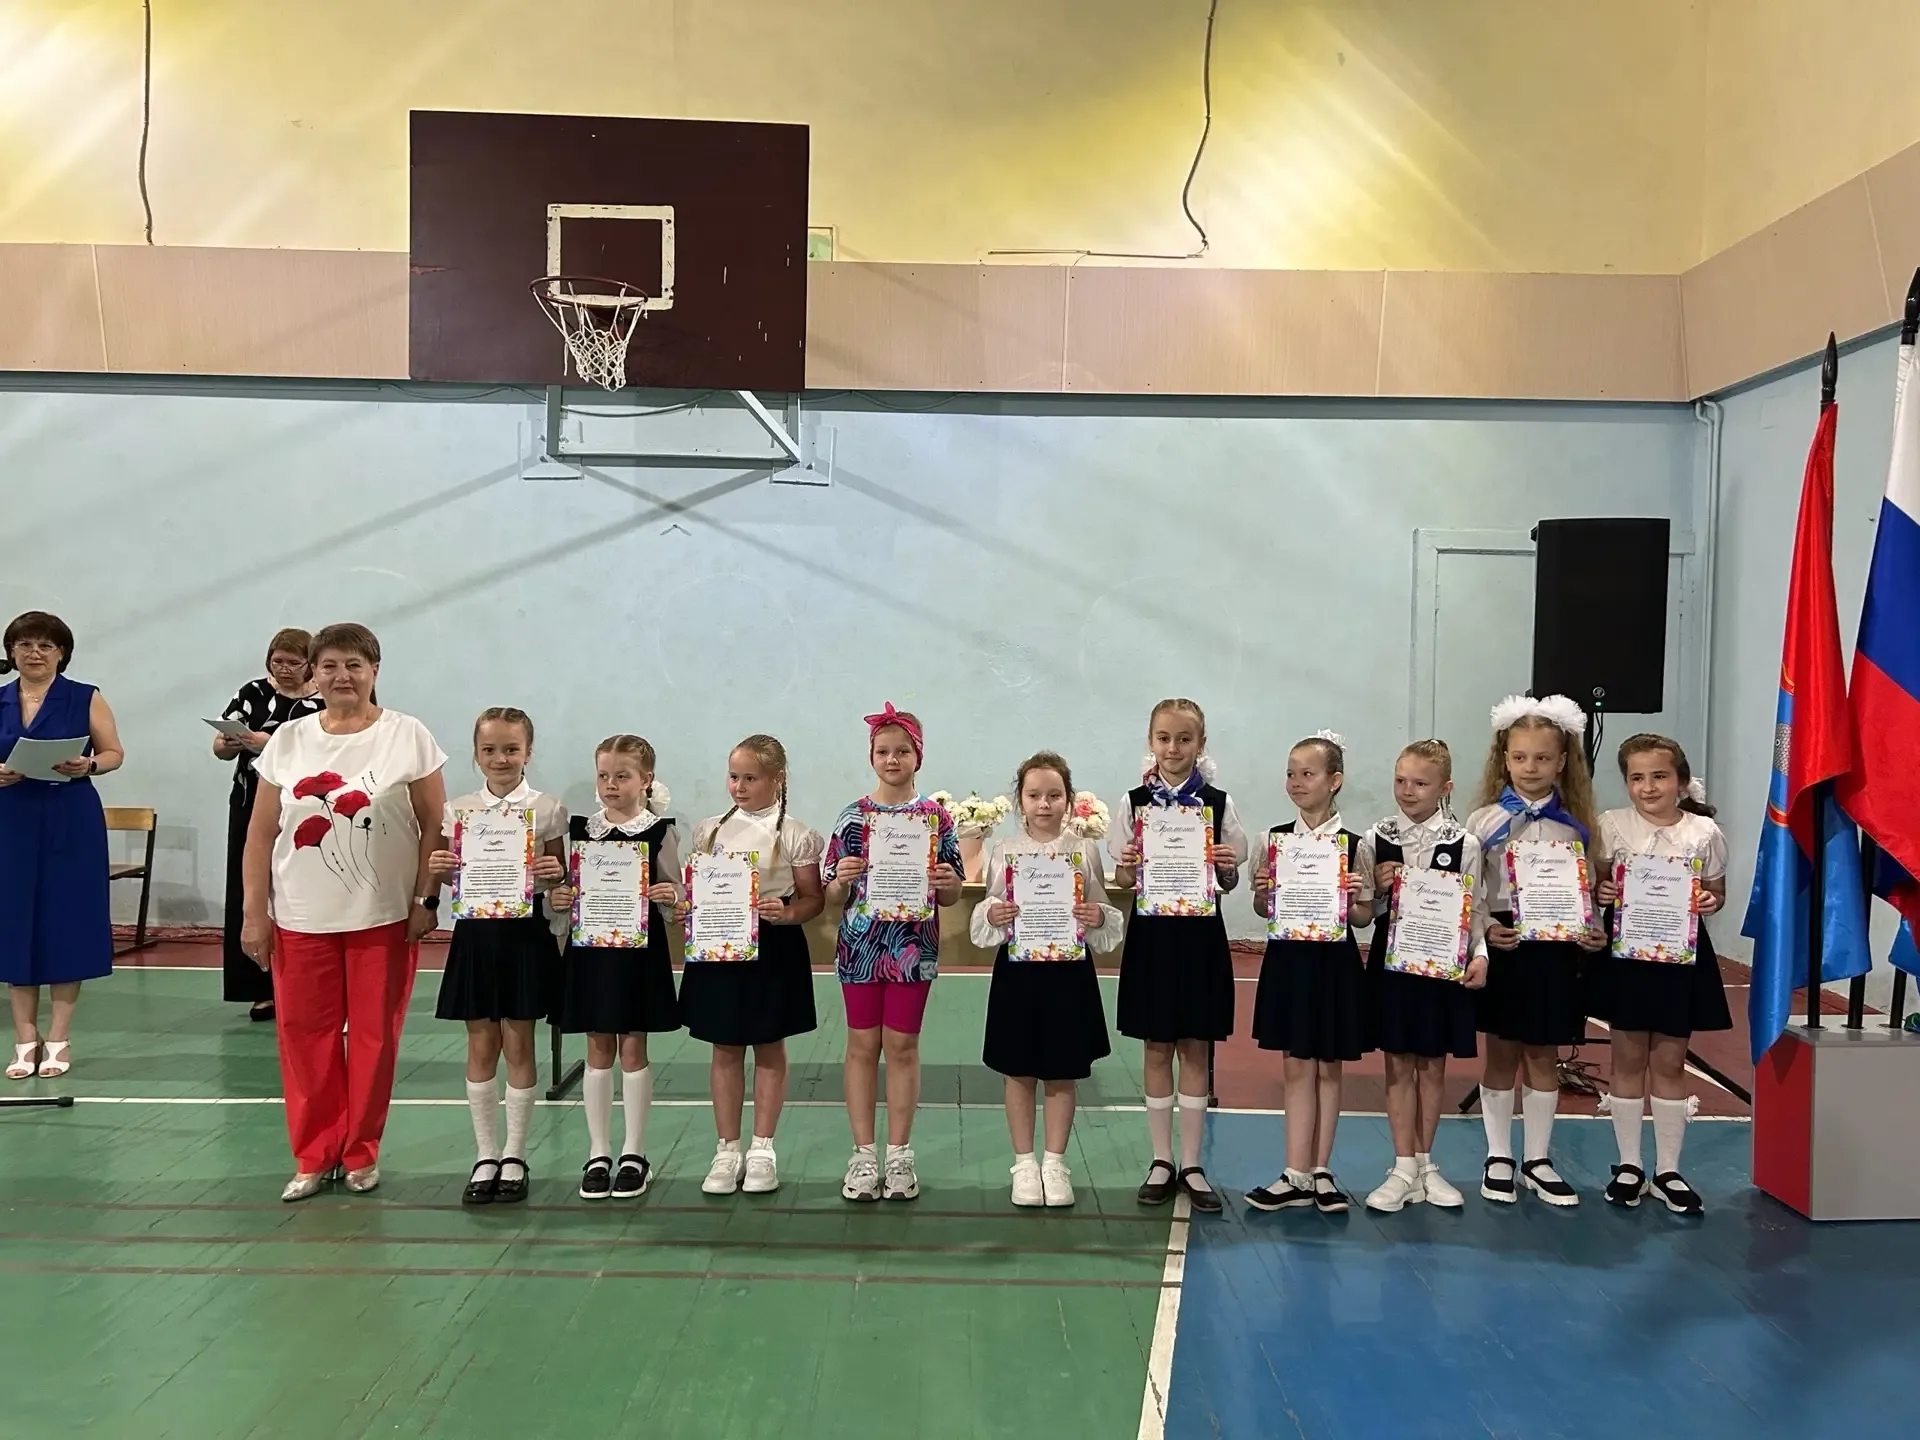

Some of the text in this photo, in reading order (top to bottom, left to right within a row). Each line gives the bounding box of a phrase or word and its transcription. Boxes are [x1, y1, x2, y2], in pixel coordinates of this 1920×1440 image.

[472, 823, 517, 840] Грамота
[878, 826, 921, 843] Грамота
[588, 854, 632, 870] Грамота
[1286, 846, 1330, 862] Грамота
[700, 866, 743, 883] Грамота
